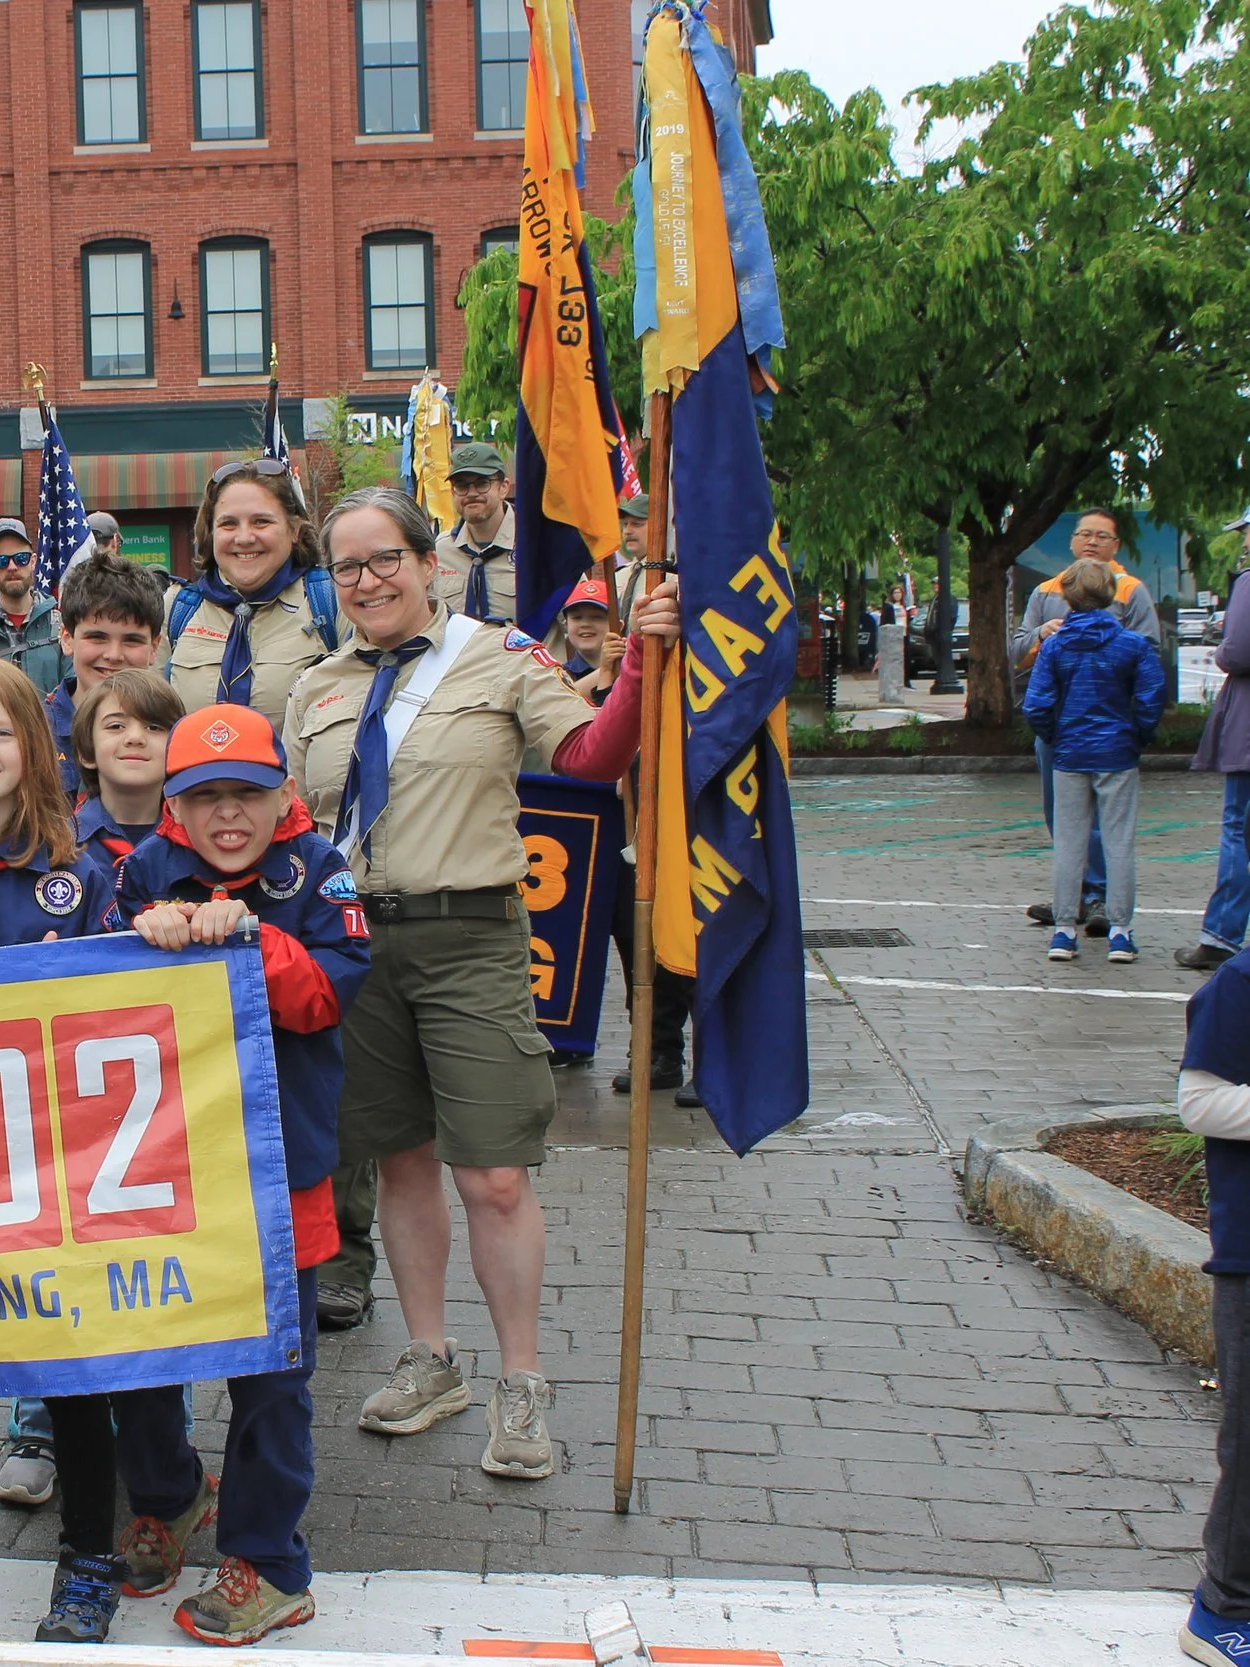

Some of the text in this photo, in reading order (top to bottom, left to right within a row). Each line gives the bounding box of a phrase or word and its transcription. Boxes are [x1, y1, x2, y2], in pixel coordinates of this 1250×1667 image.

[655, 123, 685, 137] 2019
[670, 152, 689, 287] JOURNEY TO EXCELLENCE
[142, 535, 166, 544] Bank
[106, 1256, 193, 1312] MA
